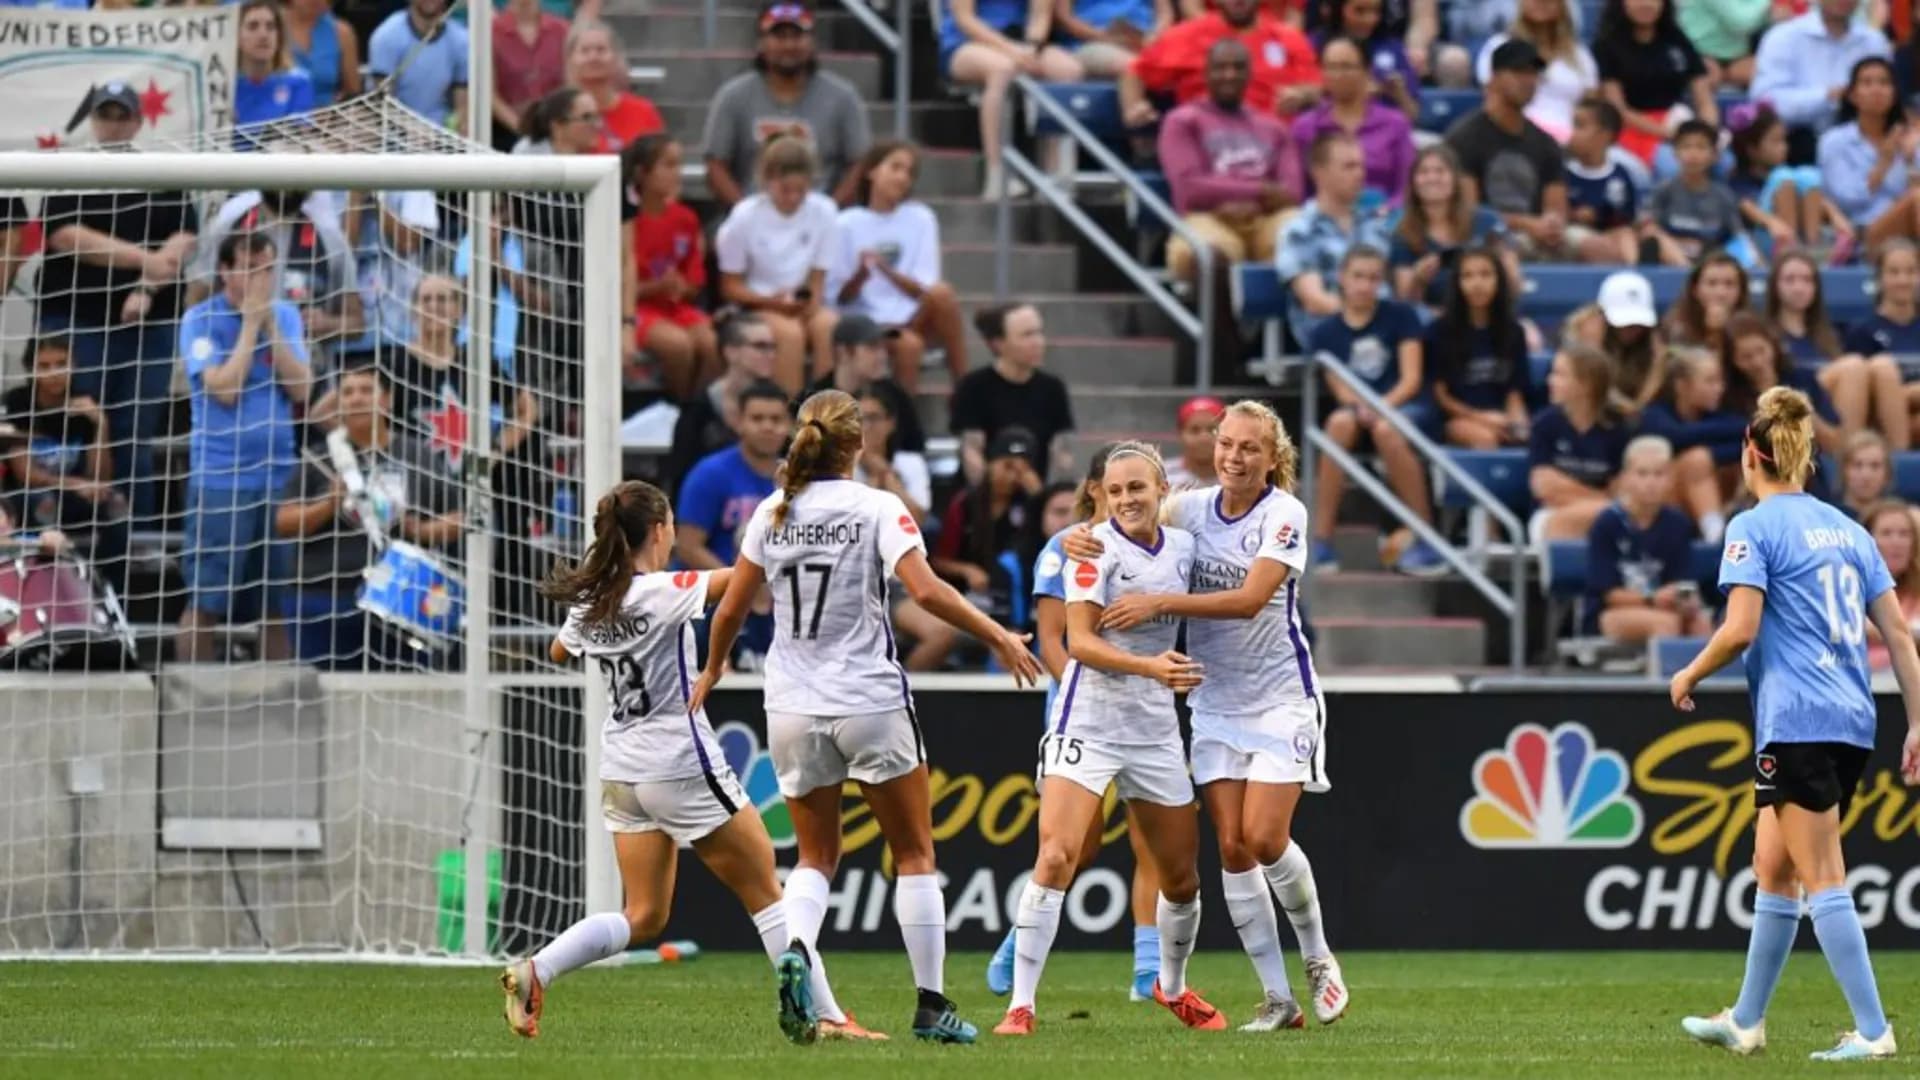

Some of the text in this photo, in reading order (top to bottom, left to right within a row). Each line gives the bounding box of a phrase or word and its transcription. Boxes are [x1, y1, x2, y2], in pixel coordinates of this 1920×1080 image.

[783, 563, 833, 640] 17
[1816, 563, 1863, 645] 13
[1055, 737, 1084, 765] 15
